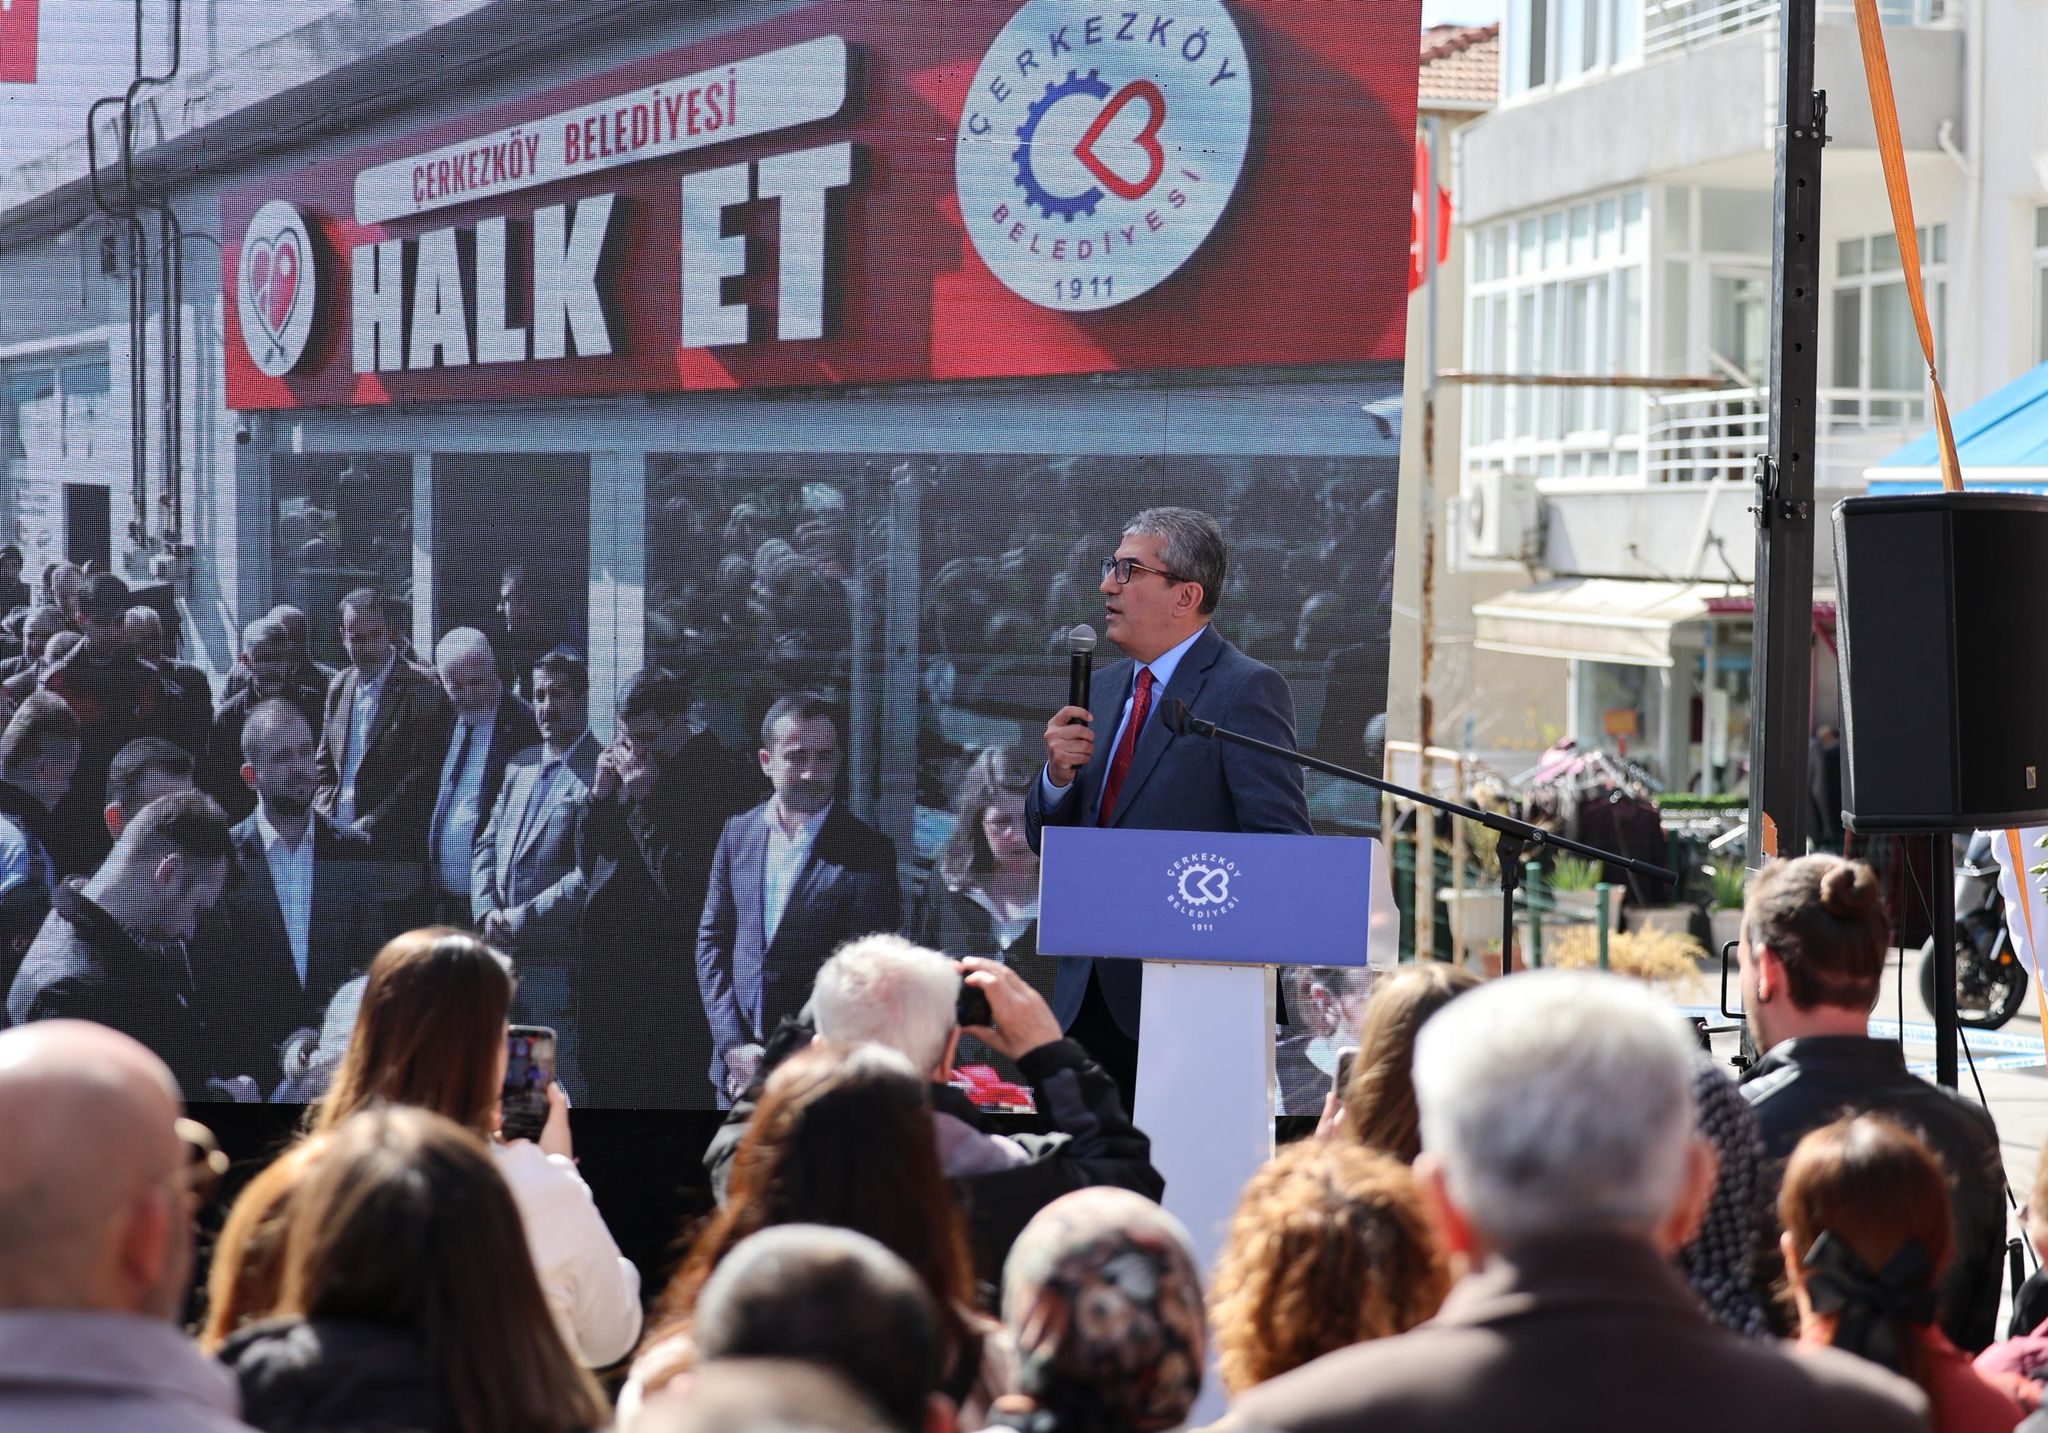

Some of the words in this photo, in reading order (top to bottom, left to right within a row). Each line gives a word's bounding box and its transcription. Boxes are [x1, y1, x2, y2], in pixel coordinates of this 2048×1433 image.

[968, 12, 1236, 136] ÇERKEZKÖY
[412, 128, 540, 209] ÇERKEZKÖY
[564, 68, 737, 165] BELEDİYESİ
[351, 193, 615, 374] HALK
[681, 142, 852, 347] ET
[1054, 276, 1114, 300] 1911
[1192, 923, 1213, 931] 1911
